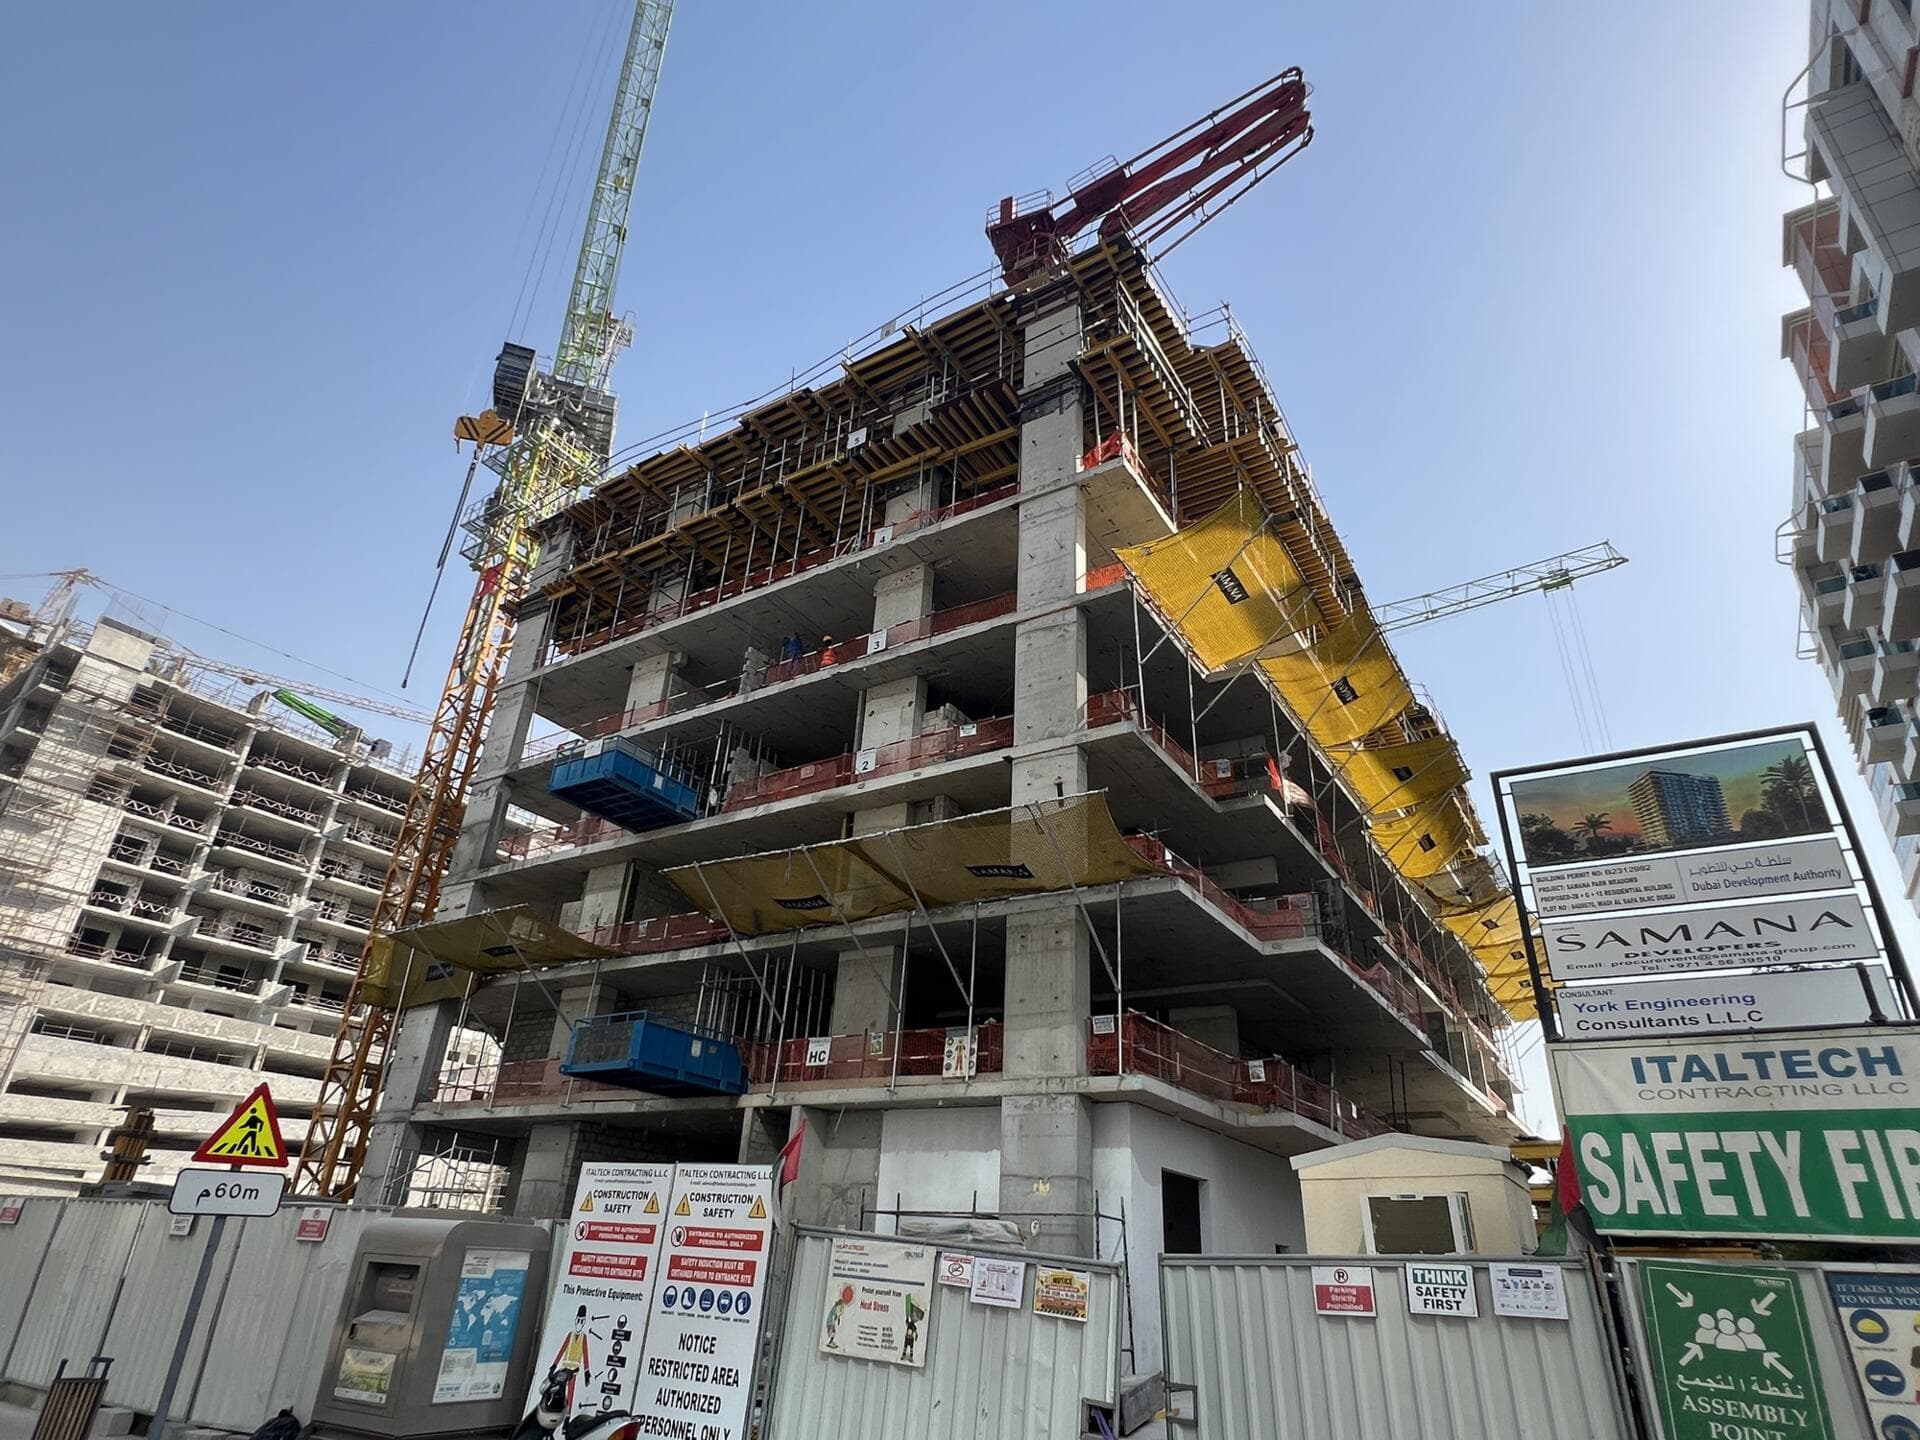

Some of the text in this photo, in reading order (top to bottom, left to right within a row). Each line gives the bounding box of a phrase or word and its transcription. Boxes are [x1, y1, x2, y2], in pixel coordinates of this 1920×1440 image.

[874, 641, 880, 650] 3
[862, 761, 869, 771] 2
[1692, 868, 1841, 891] Dubai Development Authority
[1556, 911, 1854, 952] SAMANA
[1624, 941, 1781, 958] DEVELOPERS
[1566, 943, 1855, 970] Email: procurement@samana-group.com
[1669, 961, 1699, 969] +971
[1559, 989, 1613, 999] CONSULTANT:
[1573, 994, 1756, 1014] York Engineering
[1576, 1010, 1763, 1032] Consultants L.L.C
[809, 1050, 826, 1062] HC
[1630, 1045, 1904, 1085] ITALTECH
[1638, 1081, 1909, 1101] CONTRACTING LLC
[586, 1168, 611, 1176] ITALTECH
[611, 1169, 653, 1178] CONTRACTING
[679, 1169, 708, 1178] ITALTECH
[709, 1170, 756, 1179] CONTRACTING
[1580, 1130, 1811, 1217] SAFETY
[593, 1190, 649, 1200] CONSTRUCTION
[689, 1192, 754, 1204] CONSTRUCTION
[604, 1203, 632, 1214] SAFETY
[703, 1207, 735, 1218] SAFETY
[724, 1232, 758, 1240] AUTHORIZED
[1414, 1269, 1466, 1285] THINK
[563, 1283, 644, 1301] This Protective Equipment:
[1329, 1287, 1357, 1296] Parking
[1416, 1286, 1466, 1300] SAFETY
[1848, 1284, 1886, 1293] TAKES
[1331, 1295, 1357, 1303] Strictly
[1424, 1299, 1462, 1311] FIRST
[1840, 1295, 1857, 1304] TO
[1858, 1295, 1894, 1305] WEAR
[1326, 1303, 1364, 1311] Prohibited
[678, 1332, 716, 1354] NOTICE
[648, 1357, 709, 1383] RESTRICTED
[711, 1366, 739, 1387] AREA
[1677, 1374, 1804, 1399] نقطة التجمع
[655, 1387, 721, 1414] AUTHORIZED
[1682, 1395, 1807, 1427] ASSEMBLY
[640, 1414, 697, 1440] PERSONNEL
